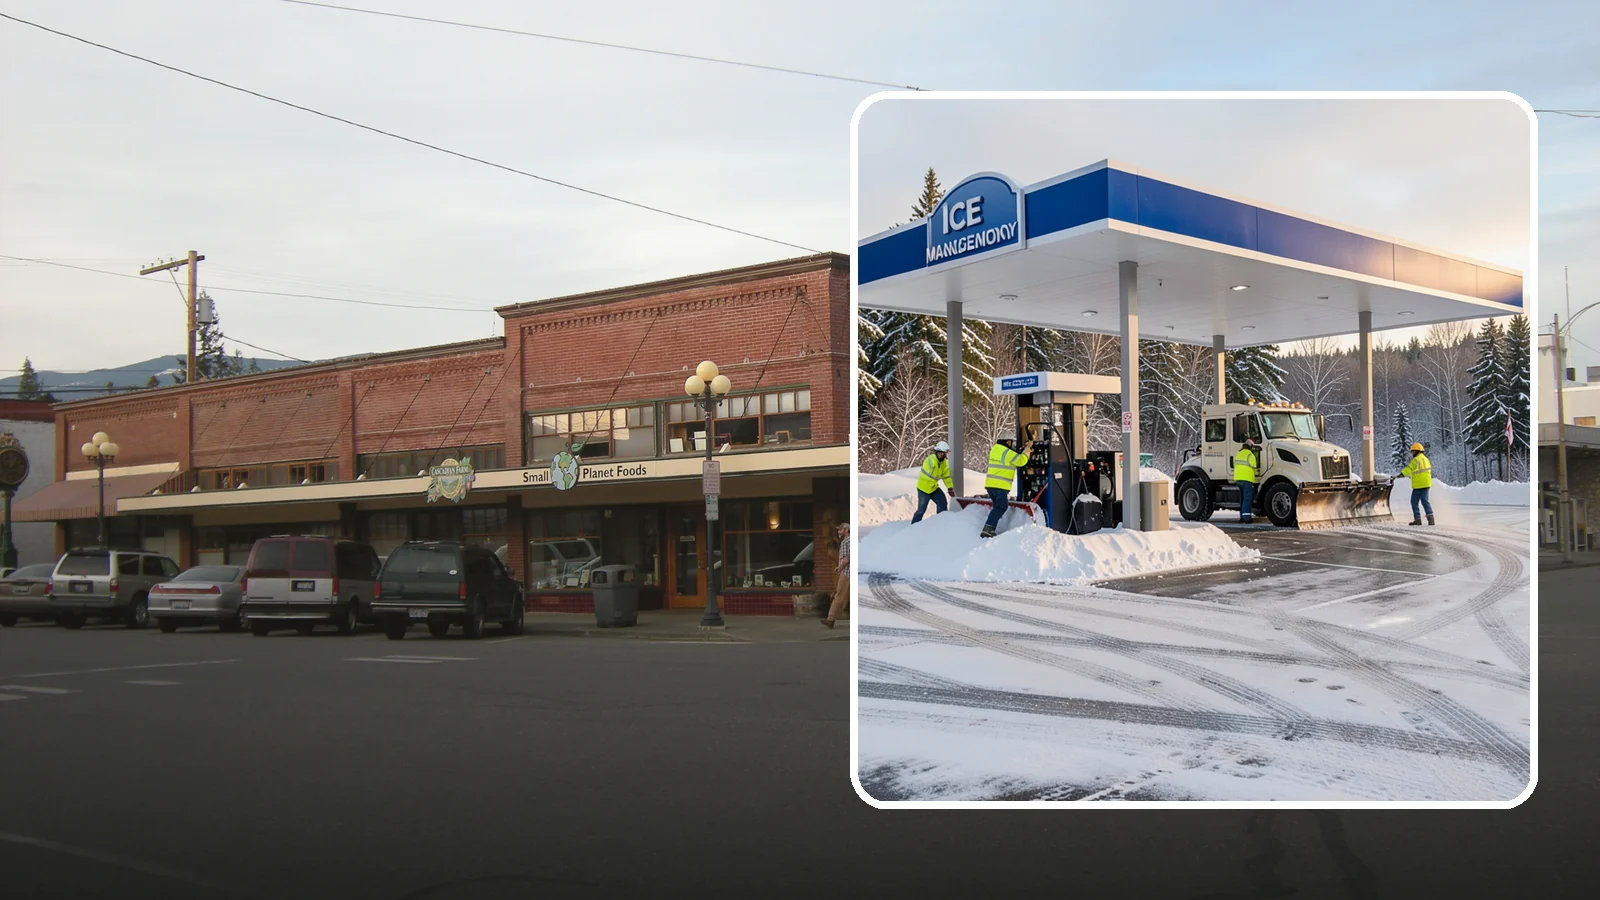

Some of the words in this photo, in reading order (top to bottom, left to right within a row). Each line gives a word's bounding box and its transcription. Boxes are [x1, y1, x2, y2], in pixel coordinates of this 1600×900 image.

[943, 196, 983, 235] ICE
[523, 470, 549, 483] Small
[582, 466, 613, 479] Planet
[616, 464, 647, 477] Foods
